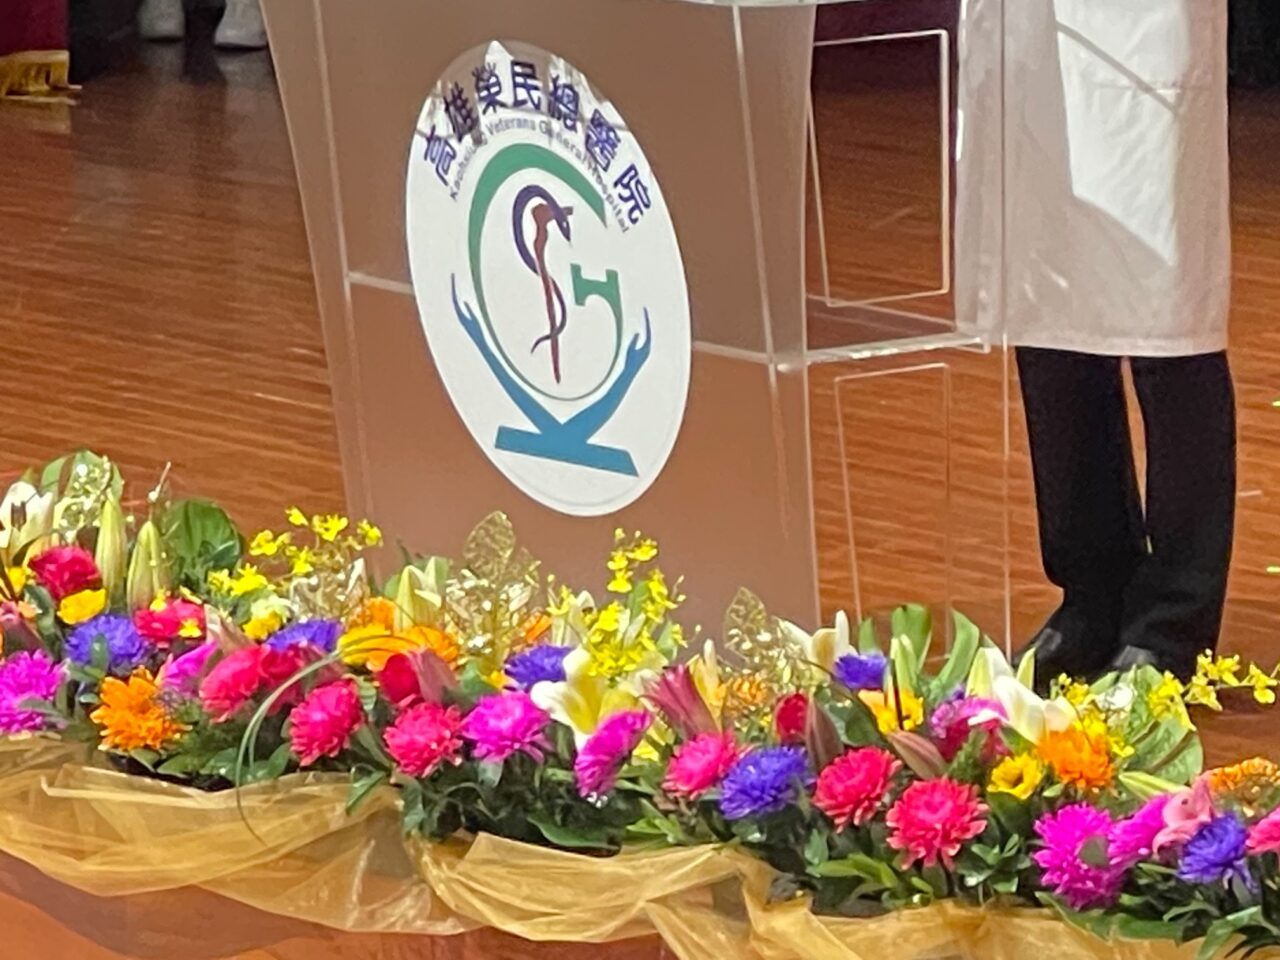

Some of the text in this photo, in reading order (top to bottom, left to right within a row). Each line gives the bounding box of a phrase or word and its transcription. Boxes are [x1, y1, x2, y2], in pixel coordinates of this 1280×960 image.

[424, 59, 652, 225] 高雄榮民總醫院
[486, 118, 536, 136] Veterans
